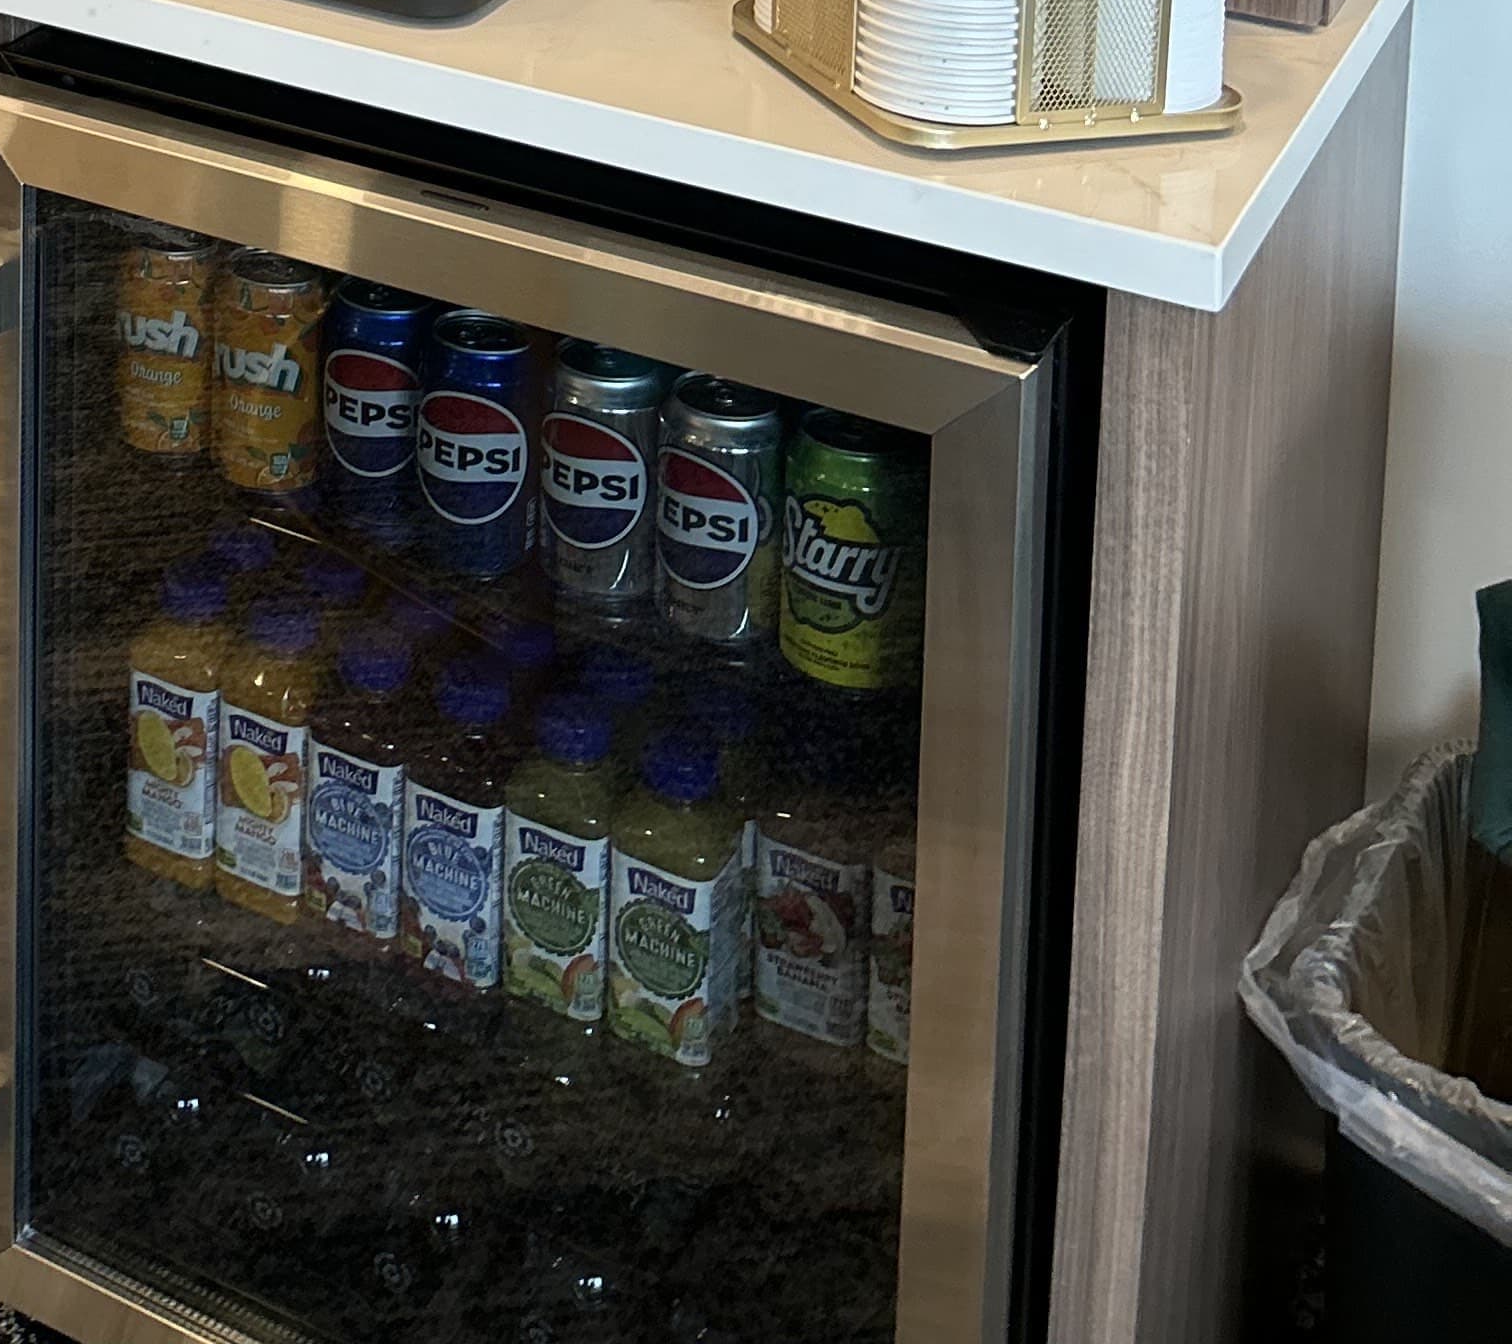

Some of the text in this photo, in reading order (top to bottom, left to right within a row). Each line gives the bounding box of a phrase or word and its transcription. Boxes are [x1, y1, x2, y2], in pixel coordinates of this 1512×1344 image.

[116, 309, 200, 359] rush
[130, 361, 182, 387] Orange
[212, 342, 301, 393] rush
[229, 393, 282, 421] Orange
[418, 423, 521, 475] PEPSI
[663, 494, 750, 543] EPSI
[783, 495, 903, 615] Starry
[315, 809, 380, 846] MACHINE
[413, 855, 480, 891] MACHINE
[529, 874, 571, 901] GREEN
[516, 888, 587, 926] MACHINE
[624, 928, 696, 969] MACHINE
[638, 915, 681, 944] GREEN
